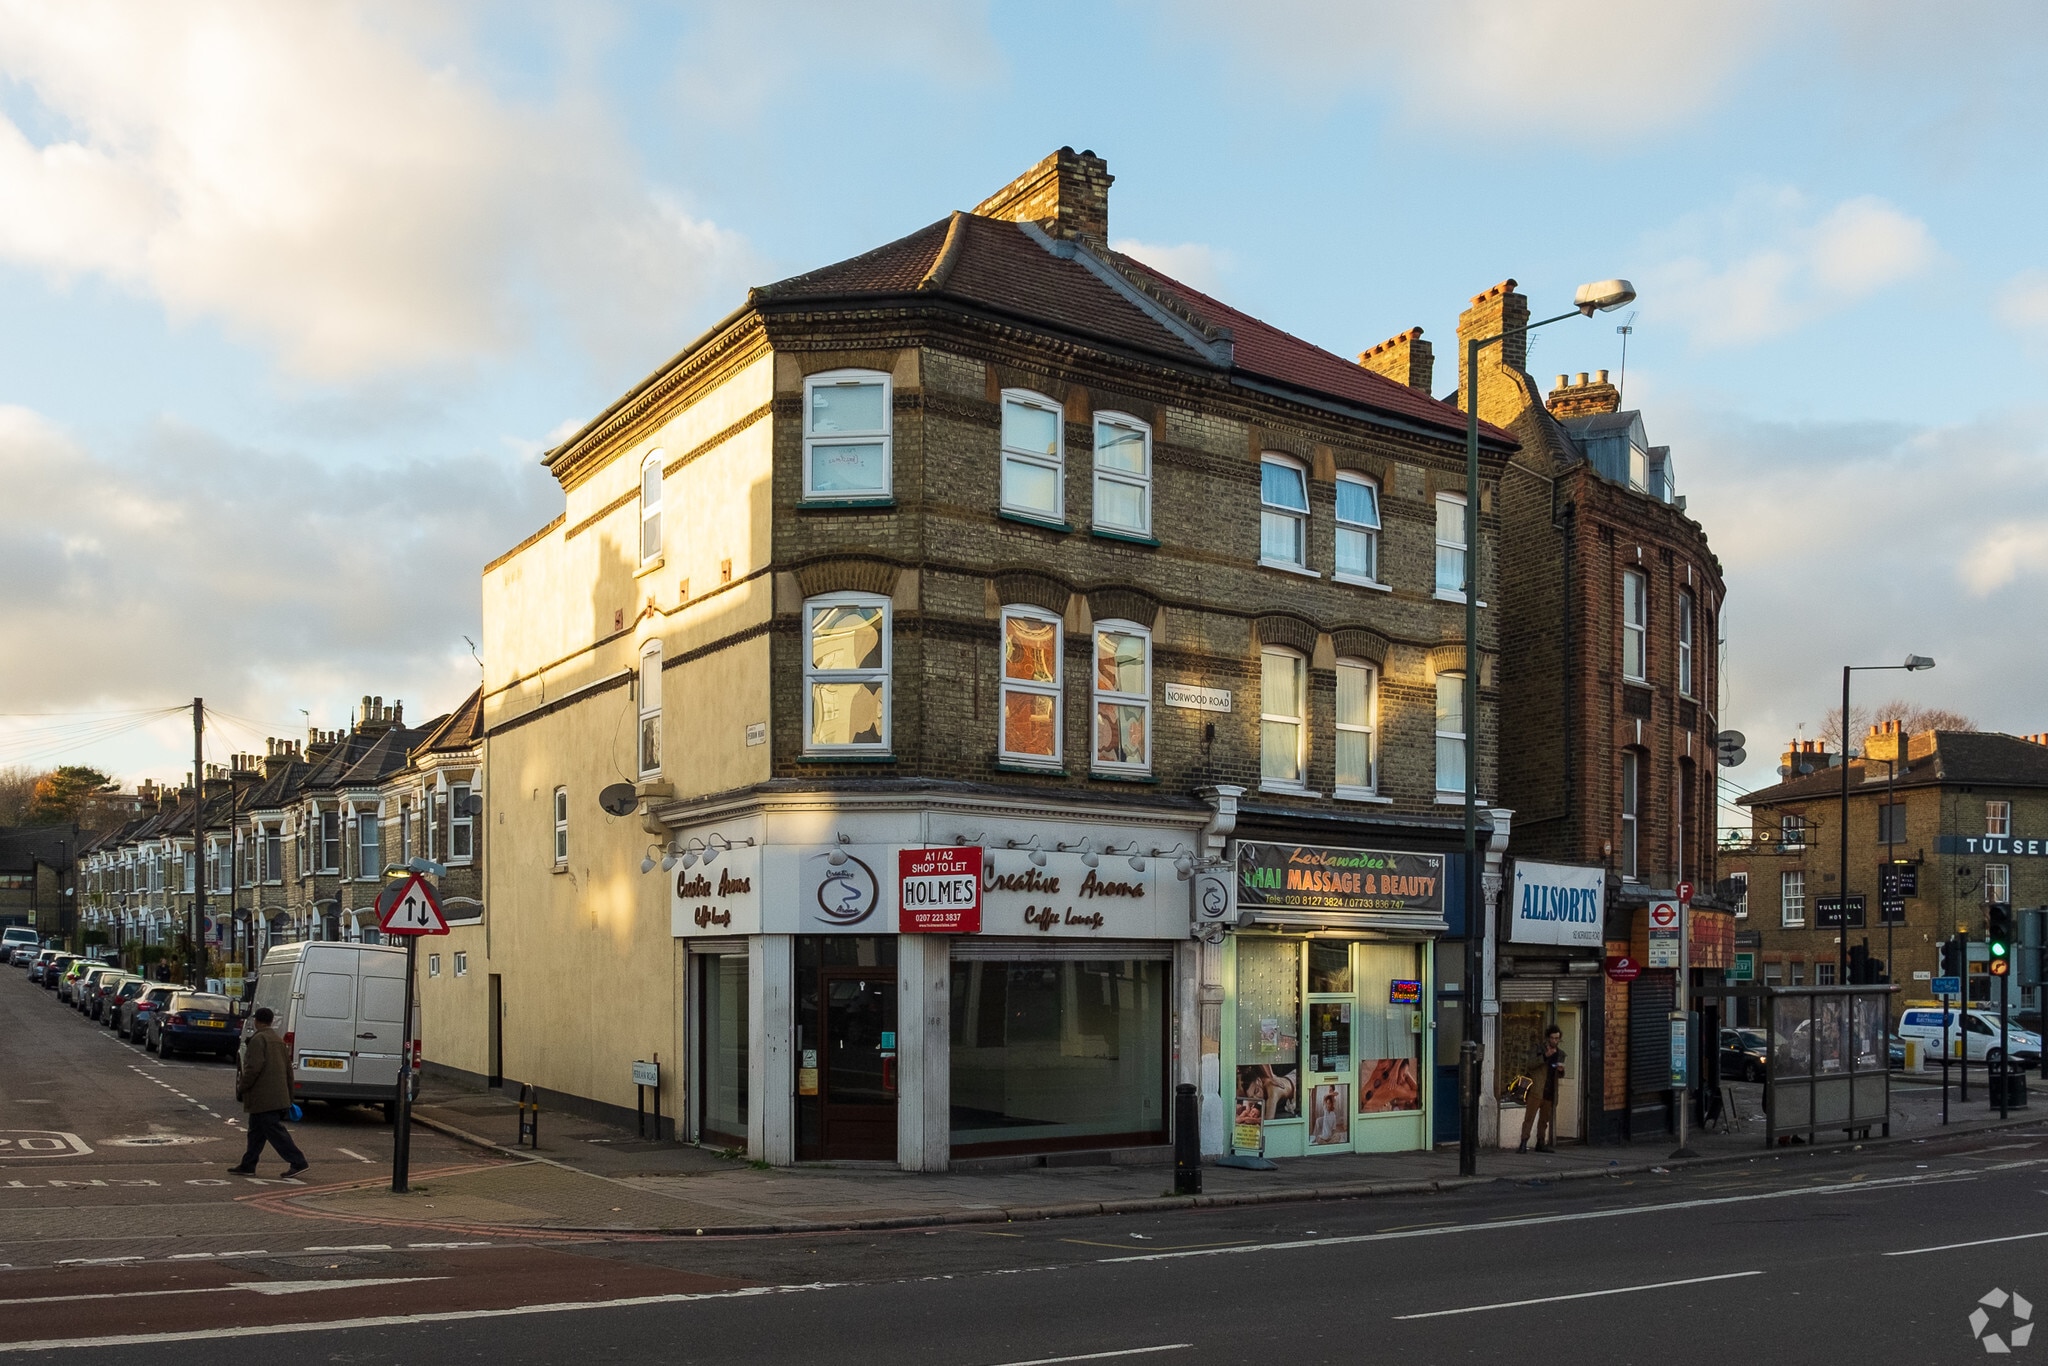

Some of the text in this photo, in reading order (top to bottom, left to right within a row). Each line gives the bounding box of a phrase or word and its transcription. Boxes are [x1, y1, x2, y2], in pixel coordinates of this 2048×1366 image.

[1167, 692, 1229, 707] NORWOOD ROAD
[1966, 838, 2038, 855] TULSE
[925, 852, 935, 861] A1
[942, 851, 953, 860] A2
[1289, 847, 1384, 869] Leelawadee
[1428, 858, 1440, 868] 164
[825, 869, 854, 878] Creative
[912, 861, 967, 873] SHOP TO LET
[677, 867, 751, 898] Creative Aroma
[983, 864, 1145, 899] Creative Aroma
[1287, 869, 1361, 893] MASSAGE
[1365, 874, 1377, 894] &
[1381, 874, 1436, 896] BEAUTY
[905, 879, 973, 905] HOLMES
[1680, 885, 1689, 898] F
[836, 904, 859, 913] Aroma
[1265, 894, 1283, 904] Tels:
[1285, 895, 1301, 905] 020
[1302, 896, 1322, 906] 8127
[1324, 898, 1343, 907] 3824
[1349, 898, 1373, 908] 07733
[1375, 899, 1389, 909] 836
[1391, 900, 1405, 909] 747
[1520, 884, 1597, 923] ALLSORTS
[915, 914, 930, 922] 0207
[945, 913, 961, 921] 3837
[1024, 905, 1104, 931] Coffee Lounge
